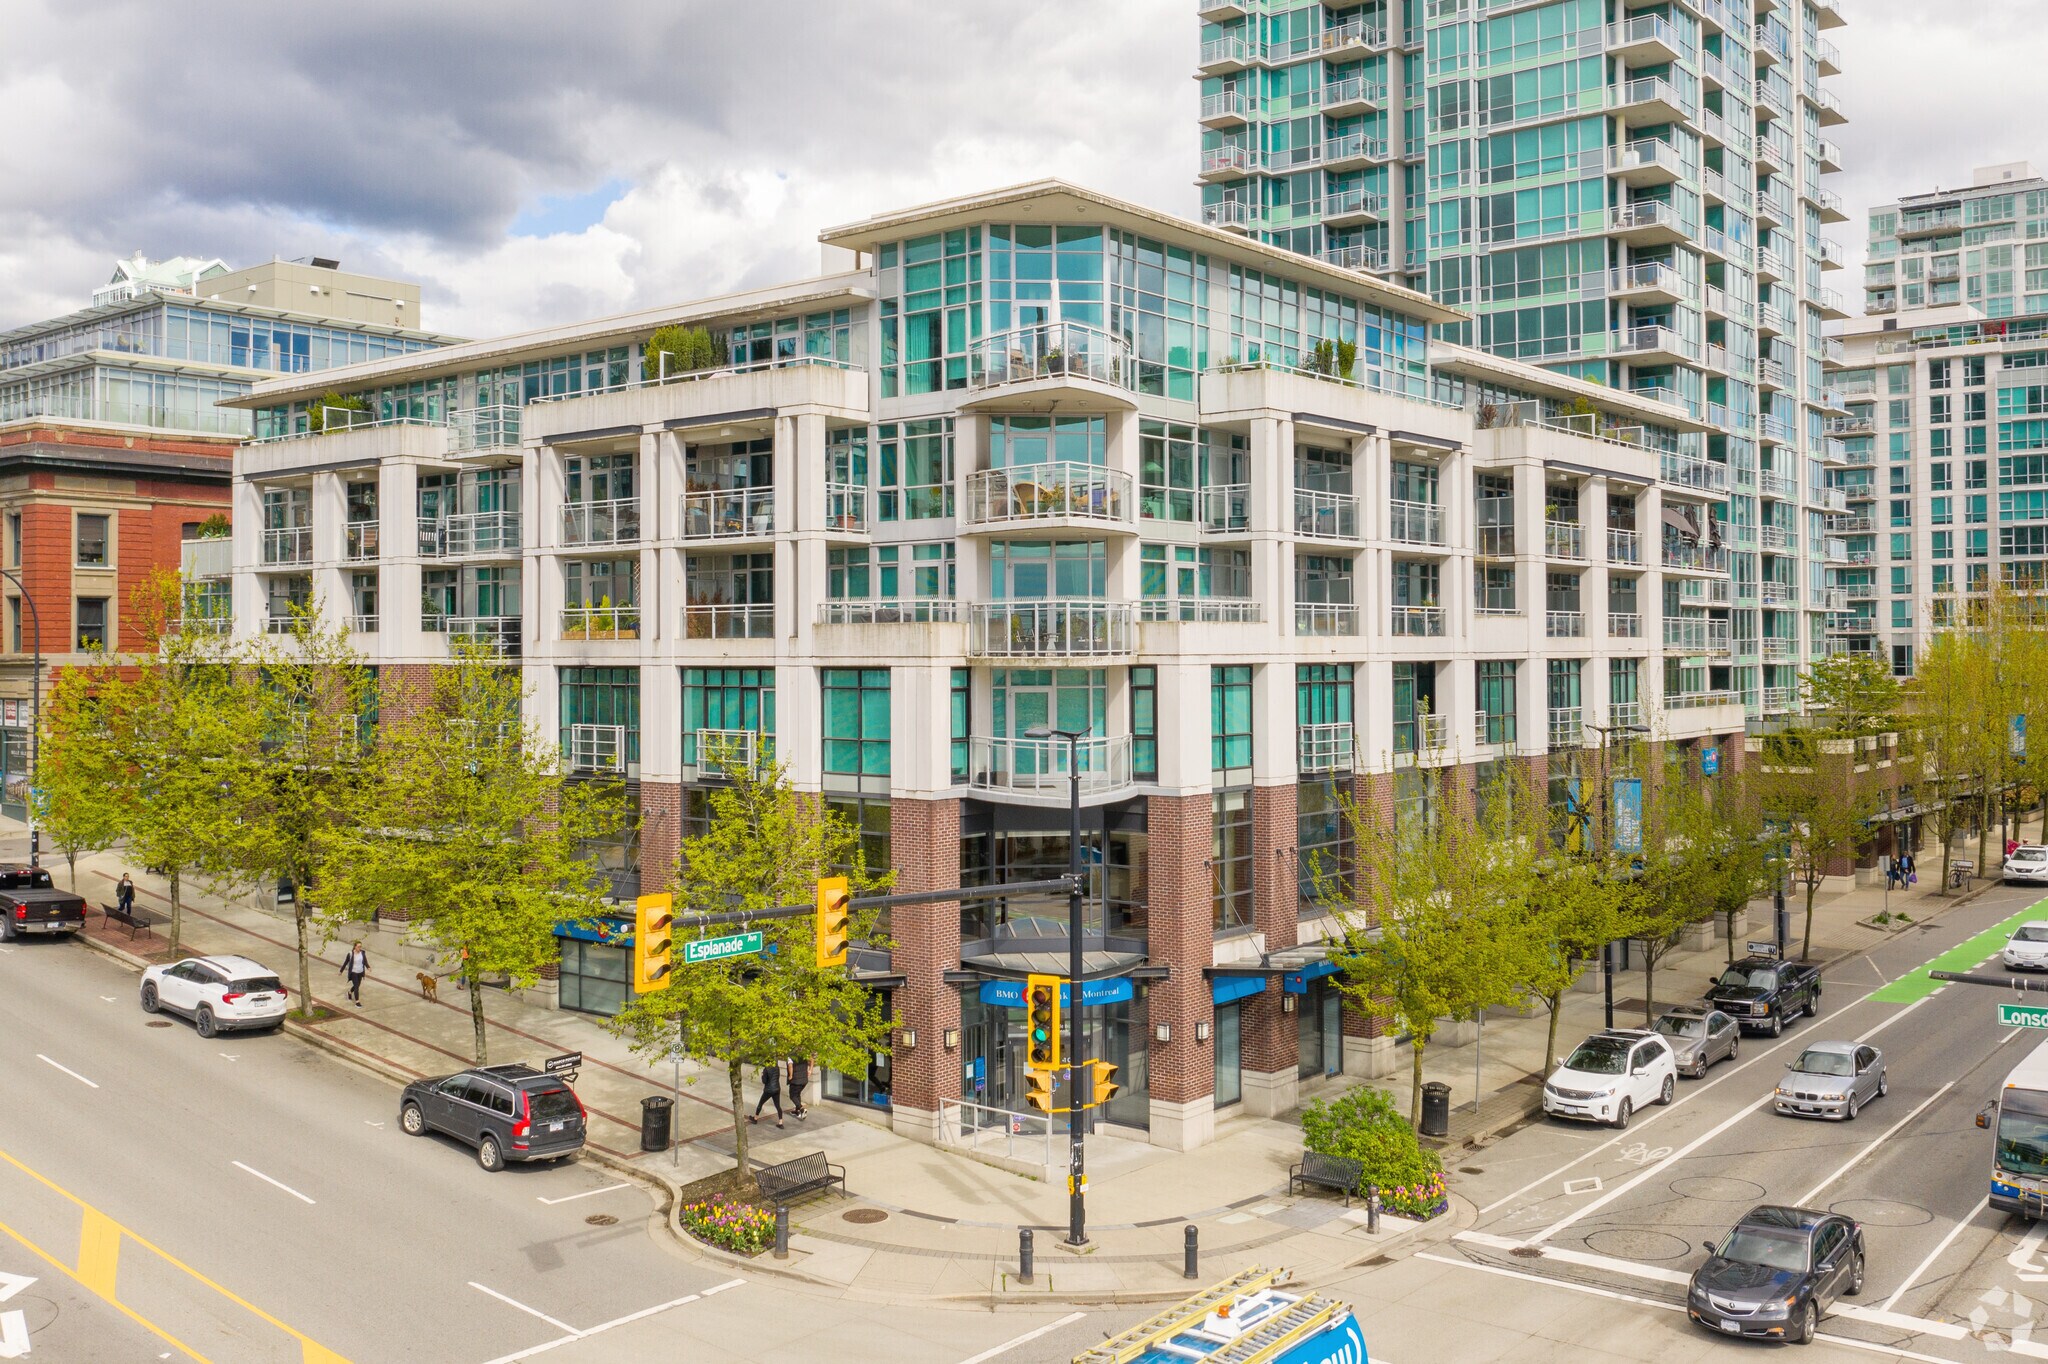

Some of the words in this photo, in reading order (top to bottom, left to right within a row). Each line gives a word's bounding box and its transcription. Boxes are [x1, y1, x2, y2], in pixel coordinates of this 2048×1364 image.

[689, 936, 744, 959] Esplanade
[747, 934, 757, 942] Ave
[996, 990, 1019, 999] BMO
[1082, 987, 1120, 999] Montreal
